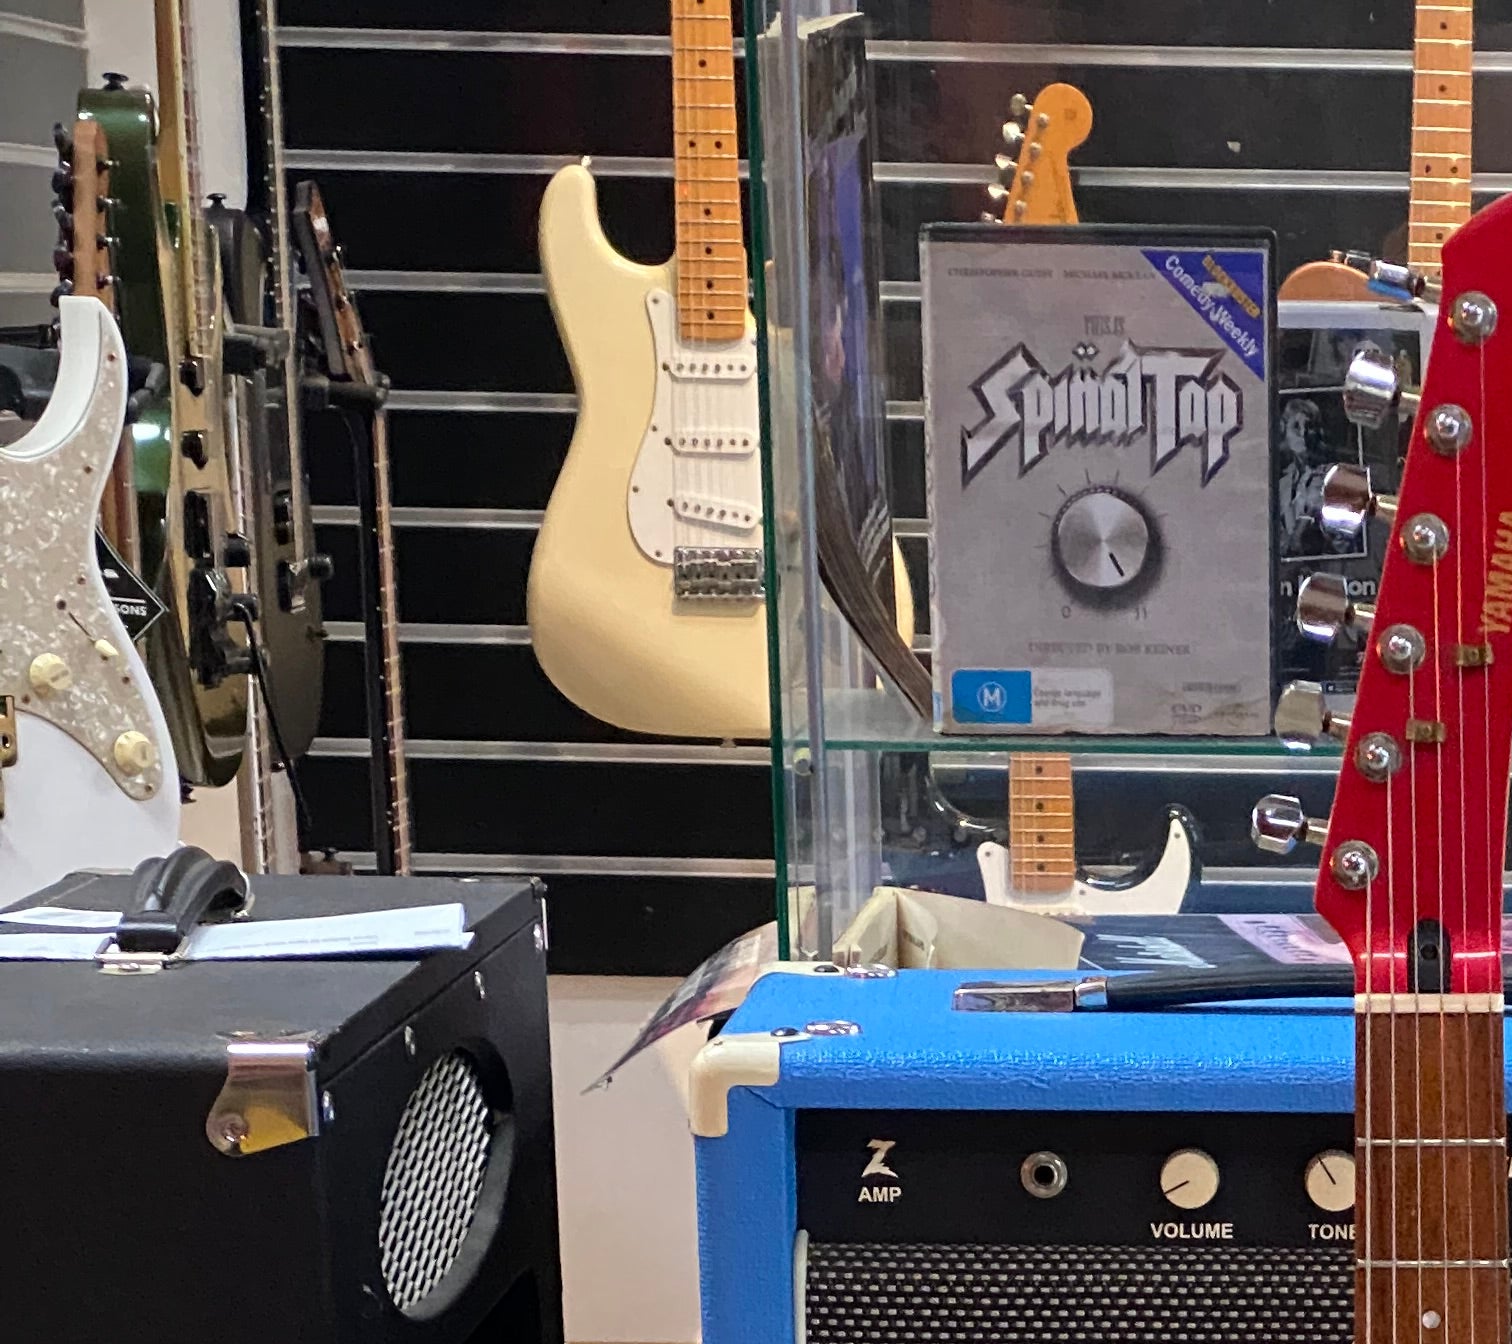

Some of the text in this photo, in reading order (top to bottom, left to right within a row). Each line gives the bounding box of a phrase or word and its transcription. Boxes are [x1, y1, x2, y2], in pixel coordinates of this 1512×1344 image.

[1165, 255, 1216, 311] Comedy
[1137, 347, 1243, 488] Tap
[858, 1187, 901, 1203] AMP
[1150, 1222, 1234, 1240] VOLUME
[1308, 1224, 1355, 1240] TONE
